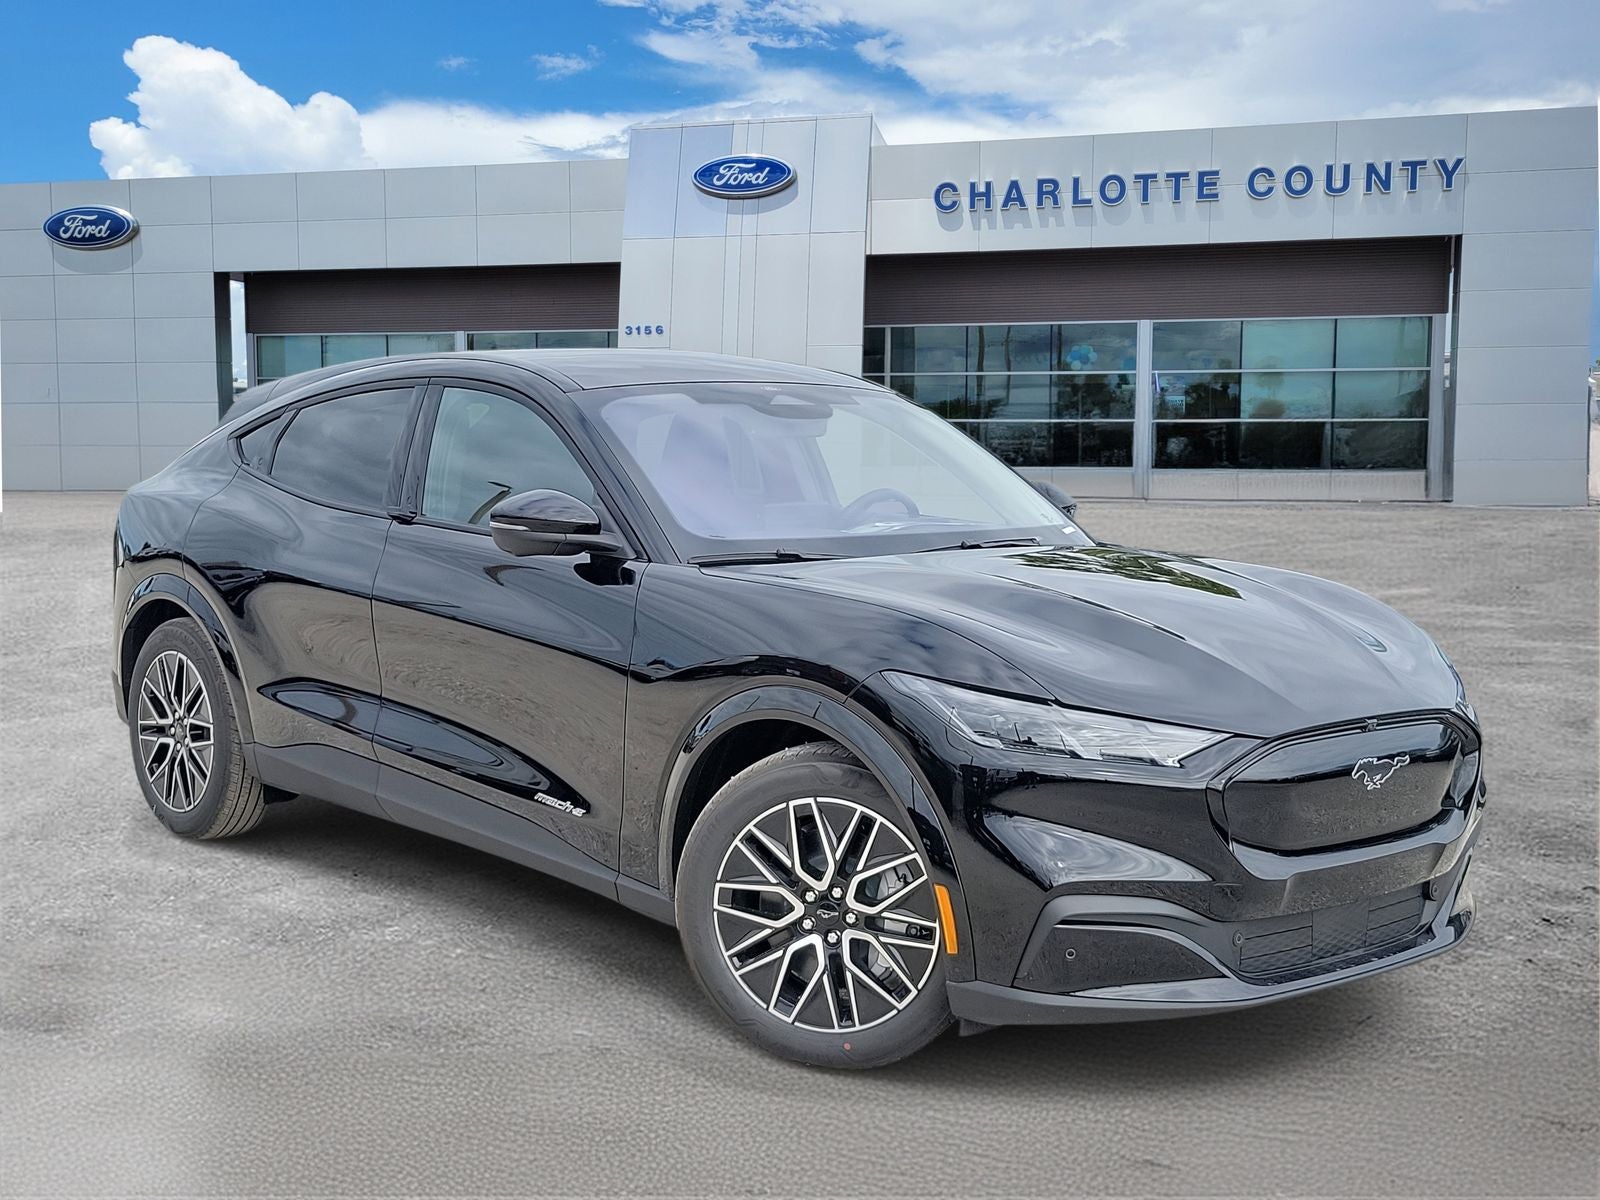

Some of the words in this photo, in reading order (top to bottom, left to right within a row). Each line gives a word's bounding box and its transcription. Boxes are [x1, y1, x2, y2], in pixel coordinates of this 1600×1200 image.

[712, 162, 770, 186] Ford
[933, 169, 1221, 214] CHARLOTTE
[1246, 156, 1466, 201] COUNTY
[59, 214, 110, 238] Ford
[624, 325, 665, 336] 3156
